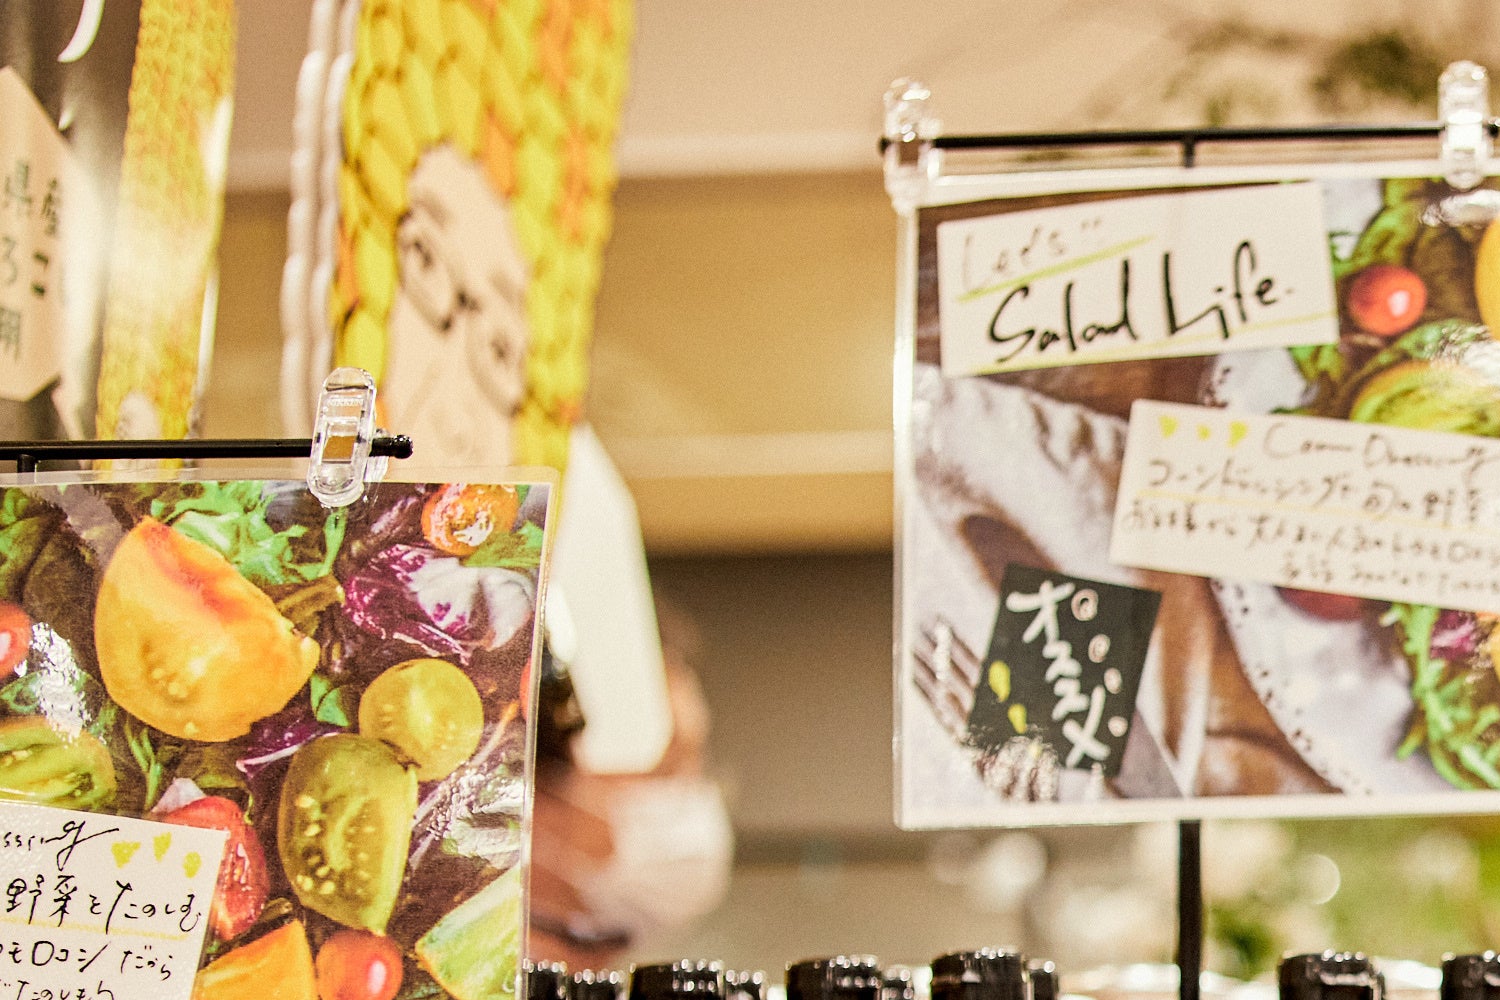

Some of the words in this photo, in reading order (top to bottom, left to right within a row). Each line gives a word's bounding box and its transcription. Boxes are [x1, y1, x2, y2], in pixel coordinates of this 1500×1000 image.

[988, 258, 1138, 364] Salad
[0, 940, 173, 981] モロコシだから
